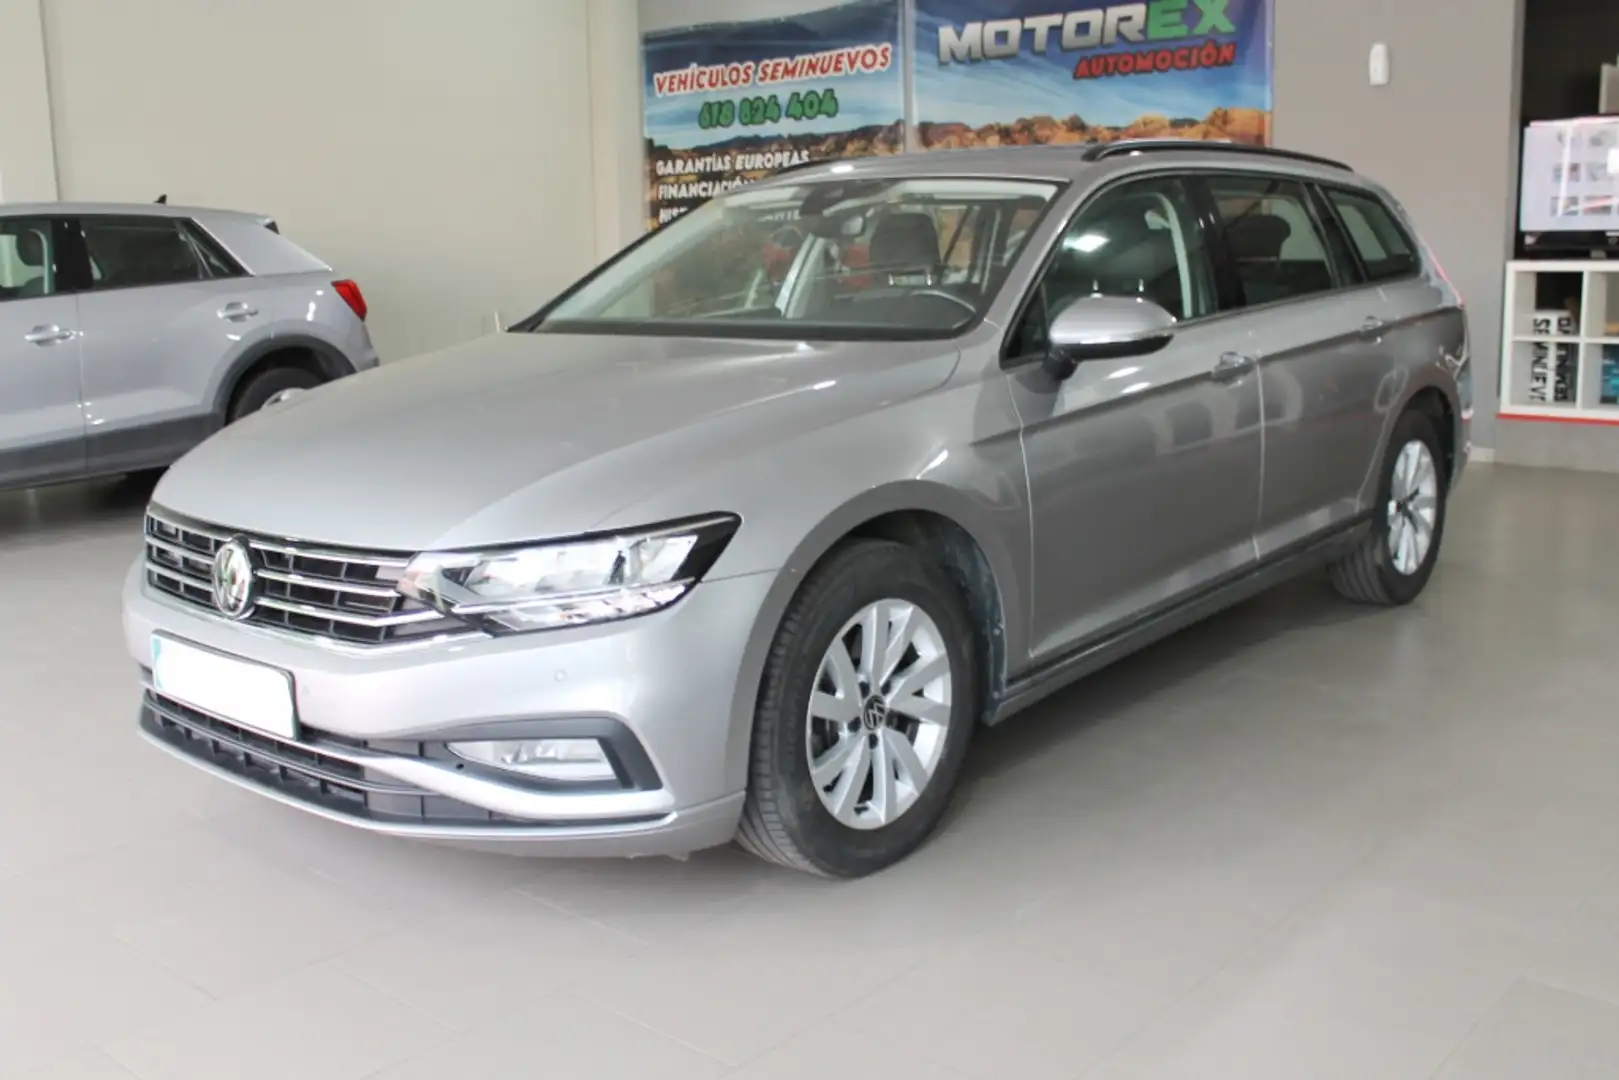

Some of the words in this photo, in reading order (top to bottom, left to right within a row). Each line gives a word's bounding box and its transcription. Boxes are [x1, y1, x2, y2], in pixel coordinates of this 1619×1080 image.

[938, 0, 1236, 65] MOTOREX
[655, 63, 753, 96] VEHÍCULOS
[757, 44, 891, 83] SEMINUEVOS
[1074, 40, 1236, 79] AUTOMOCIÓN
[786, 88, 839, 120] 404
[656, 152, 731, 176] GARANTÍAS
[735, 150, 810, 171] EUROPEAS
[658, 176, 757, 200] FINANCIACIÓ
